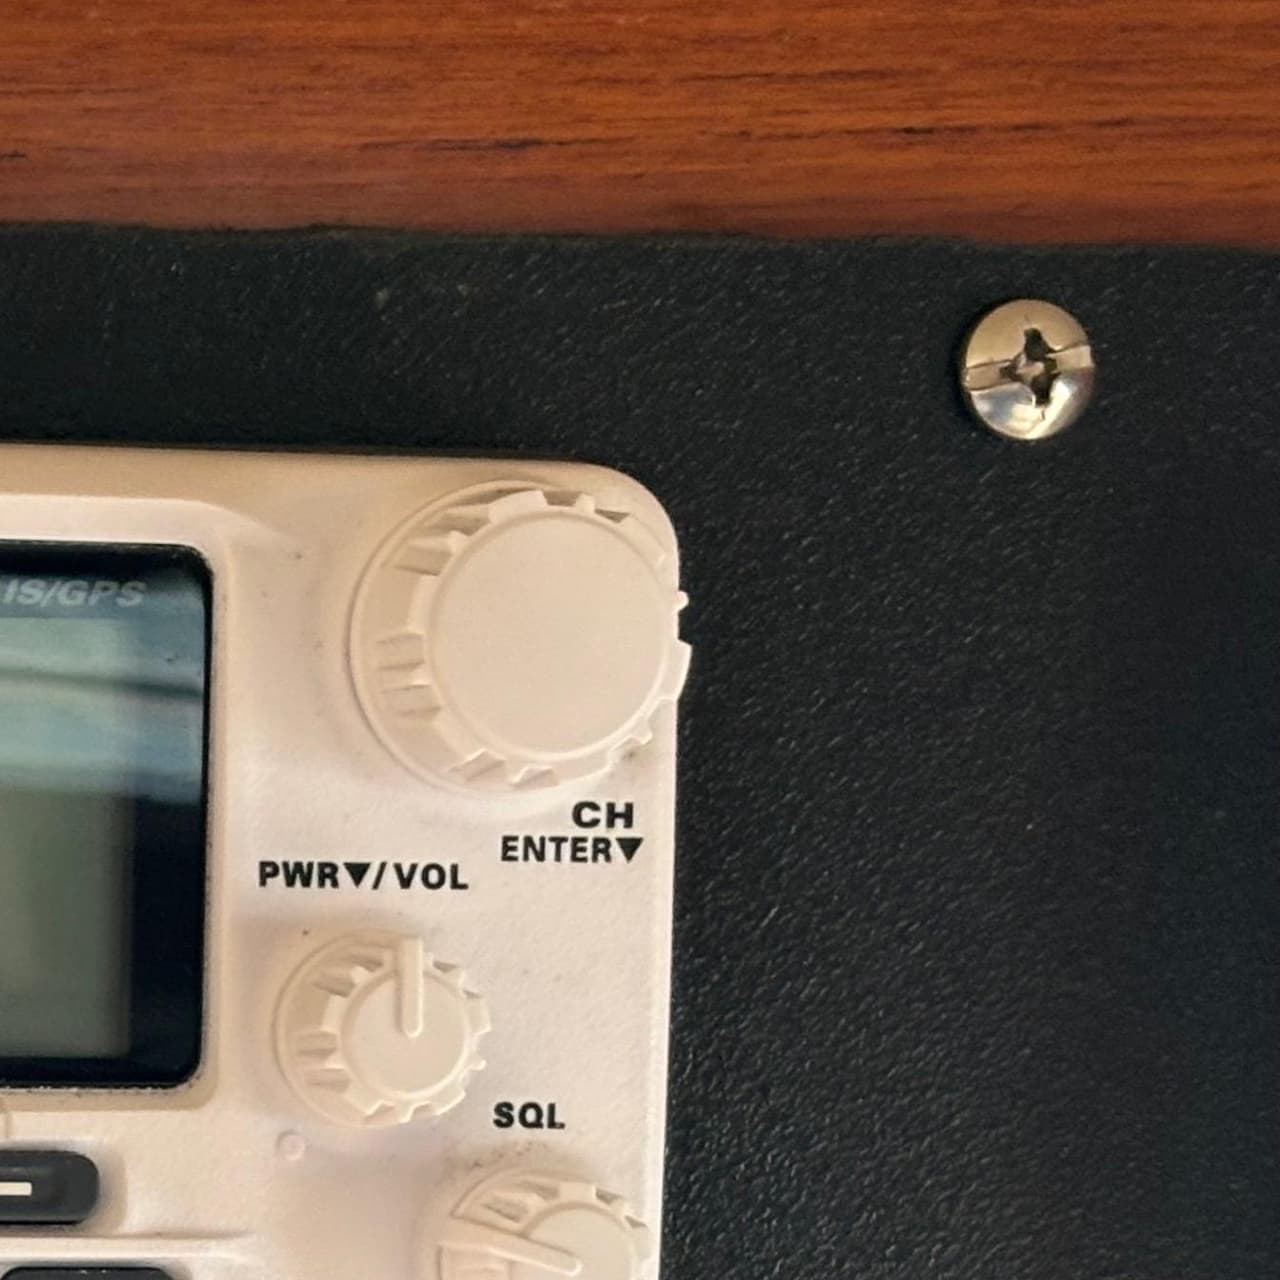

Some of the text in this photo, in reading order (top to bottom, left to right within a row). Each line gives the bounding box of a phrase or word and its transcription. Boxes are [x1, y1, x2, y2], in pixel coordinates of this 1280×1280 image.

[571, 800, 635, 830] CH
[500, 835, 613, 864] ENTER
[492, 1101, 566, 1130] SQL
